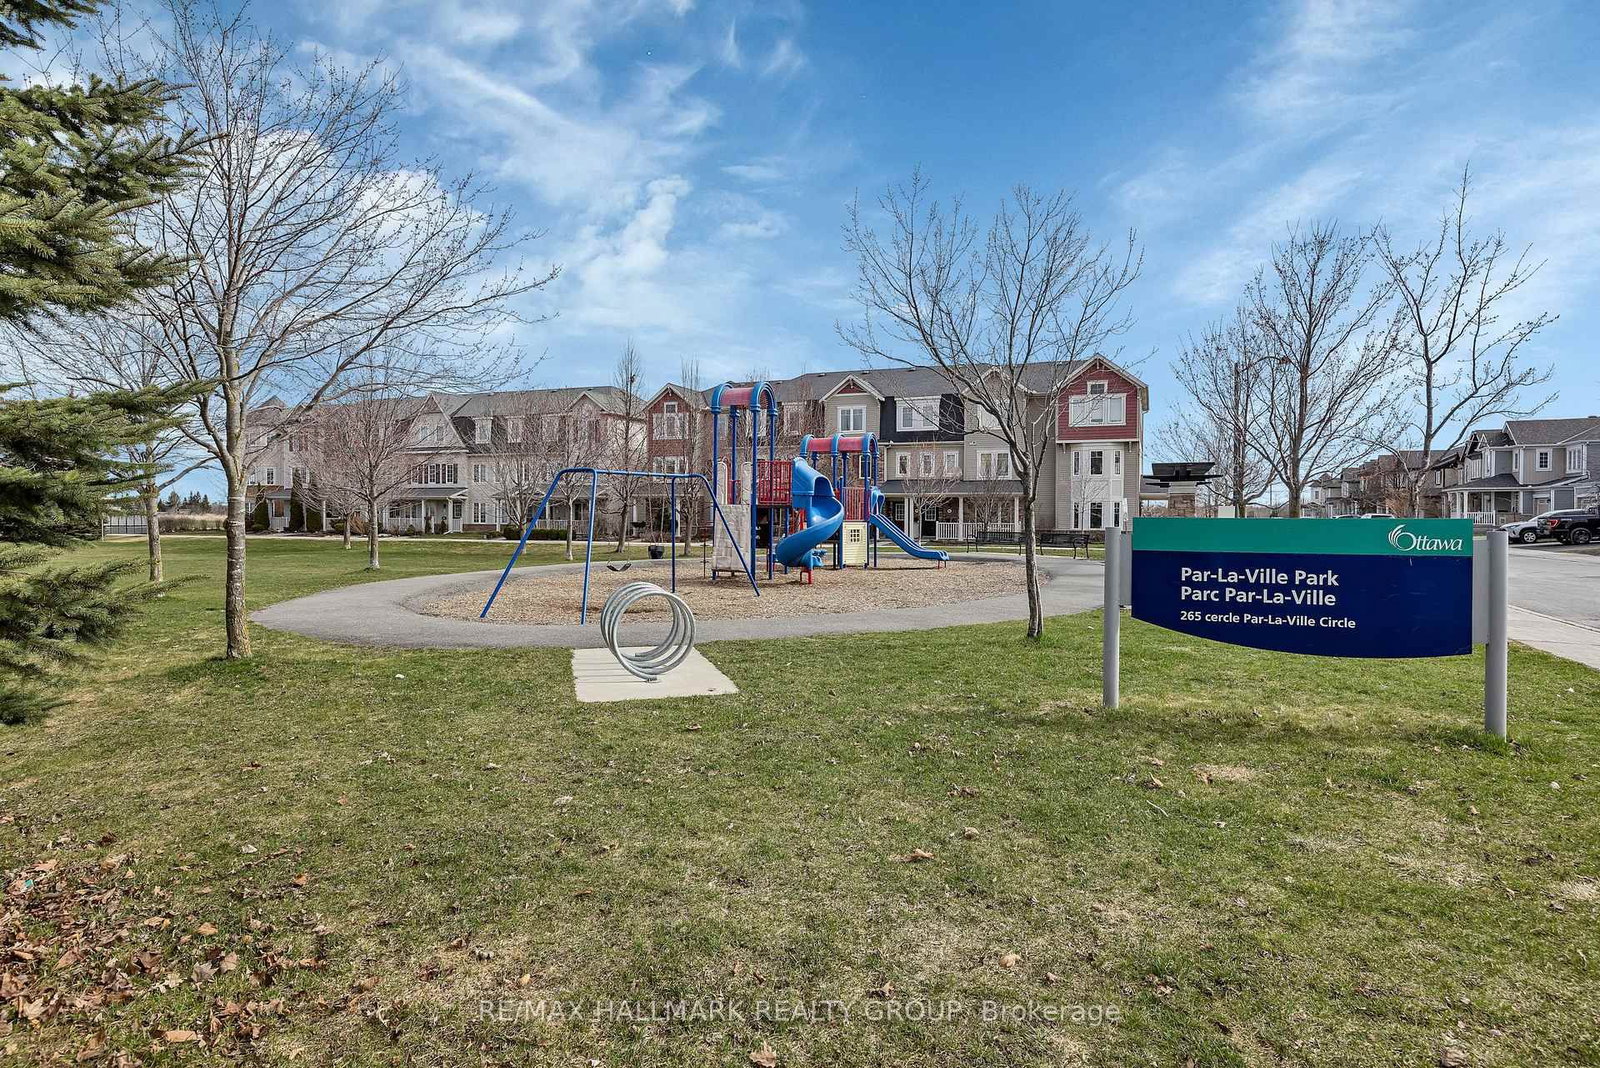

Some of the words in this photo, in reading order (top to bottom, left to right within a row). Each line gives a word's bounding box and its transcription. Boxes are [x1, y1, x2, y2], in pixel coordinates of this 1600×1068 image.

[1388, 524, 1464, 552] Ottawa
[1180, 567, 1289, 585] Par-La-Ville
[1294, 569, 1340, 586] Park
[1180, 586, 1220, 602] Parc
[1225, 587, 1337, 606] Par-La-Ville
[1180, 610, 1202, 622] 265
[1206, 612, 1240, 623] cercle
[1243, 613, 1316, 627] Par-La-Ville
[1319, 616, 1356, 629] Circle
